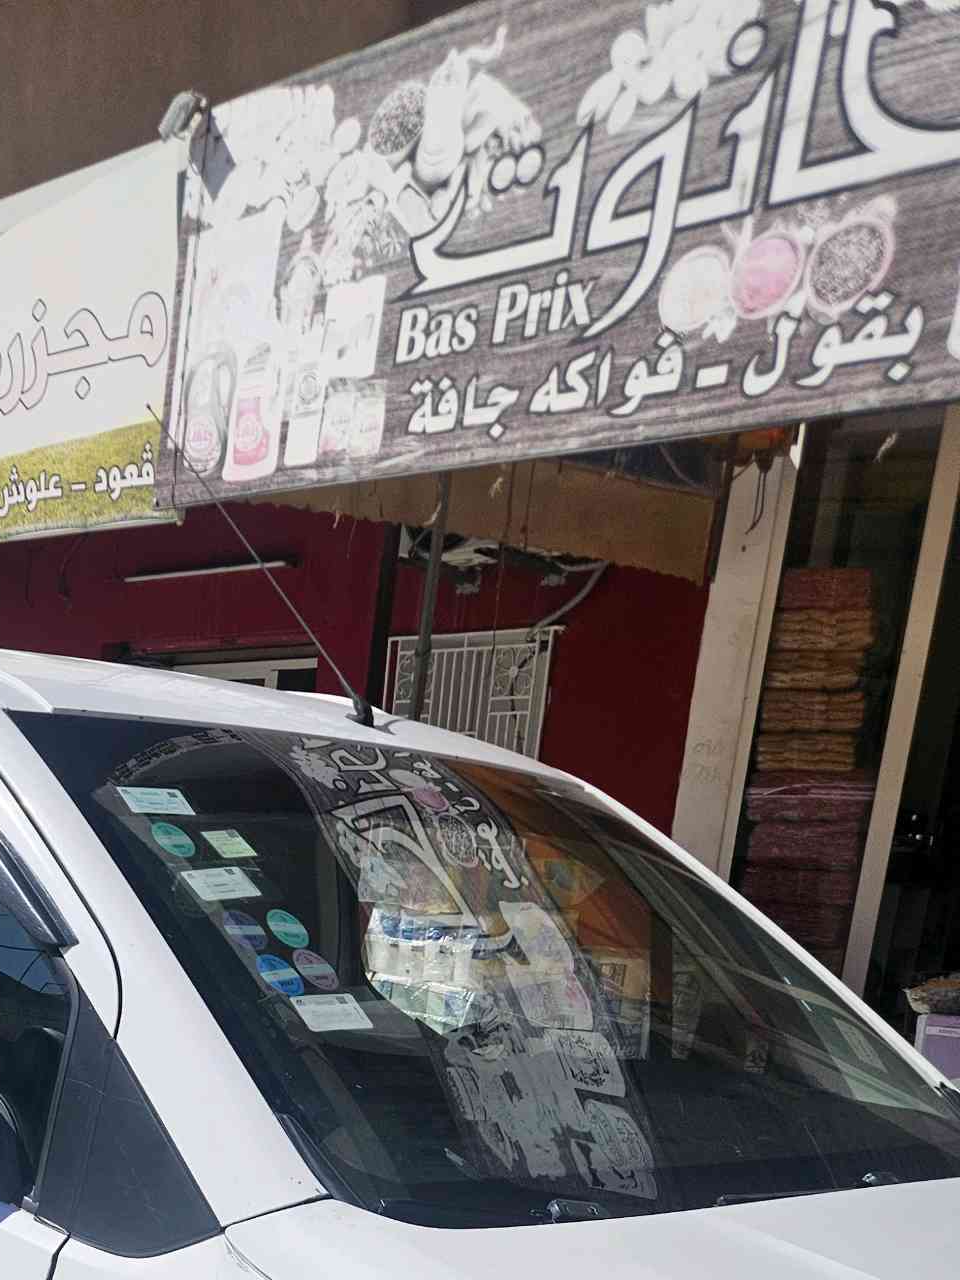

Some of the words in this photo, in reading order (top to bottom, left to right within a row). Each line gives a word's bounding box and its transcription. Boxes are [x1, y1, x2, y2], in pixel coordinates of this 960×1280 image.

[395, 304, 478, 365] Bas
[491, 272, 595, 344] Prix
[742, 290, 925, 397] بقول
[407, 375, 520, 439] جافة
[529, 331, 683, 416] فواكه
